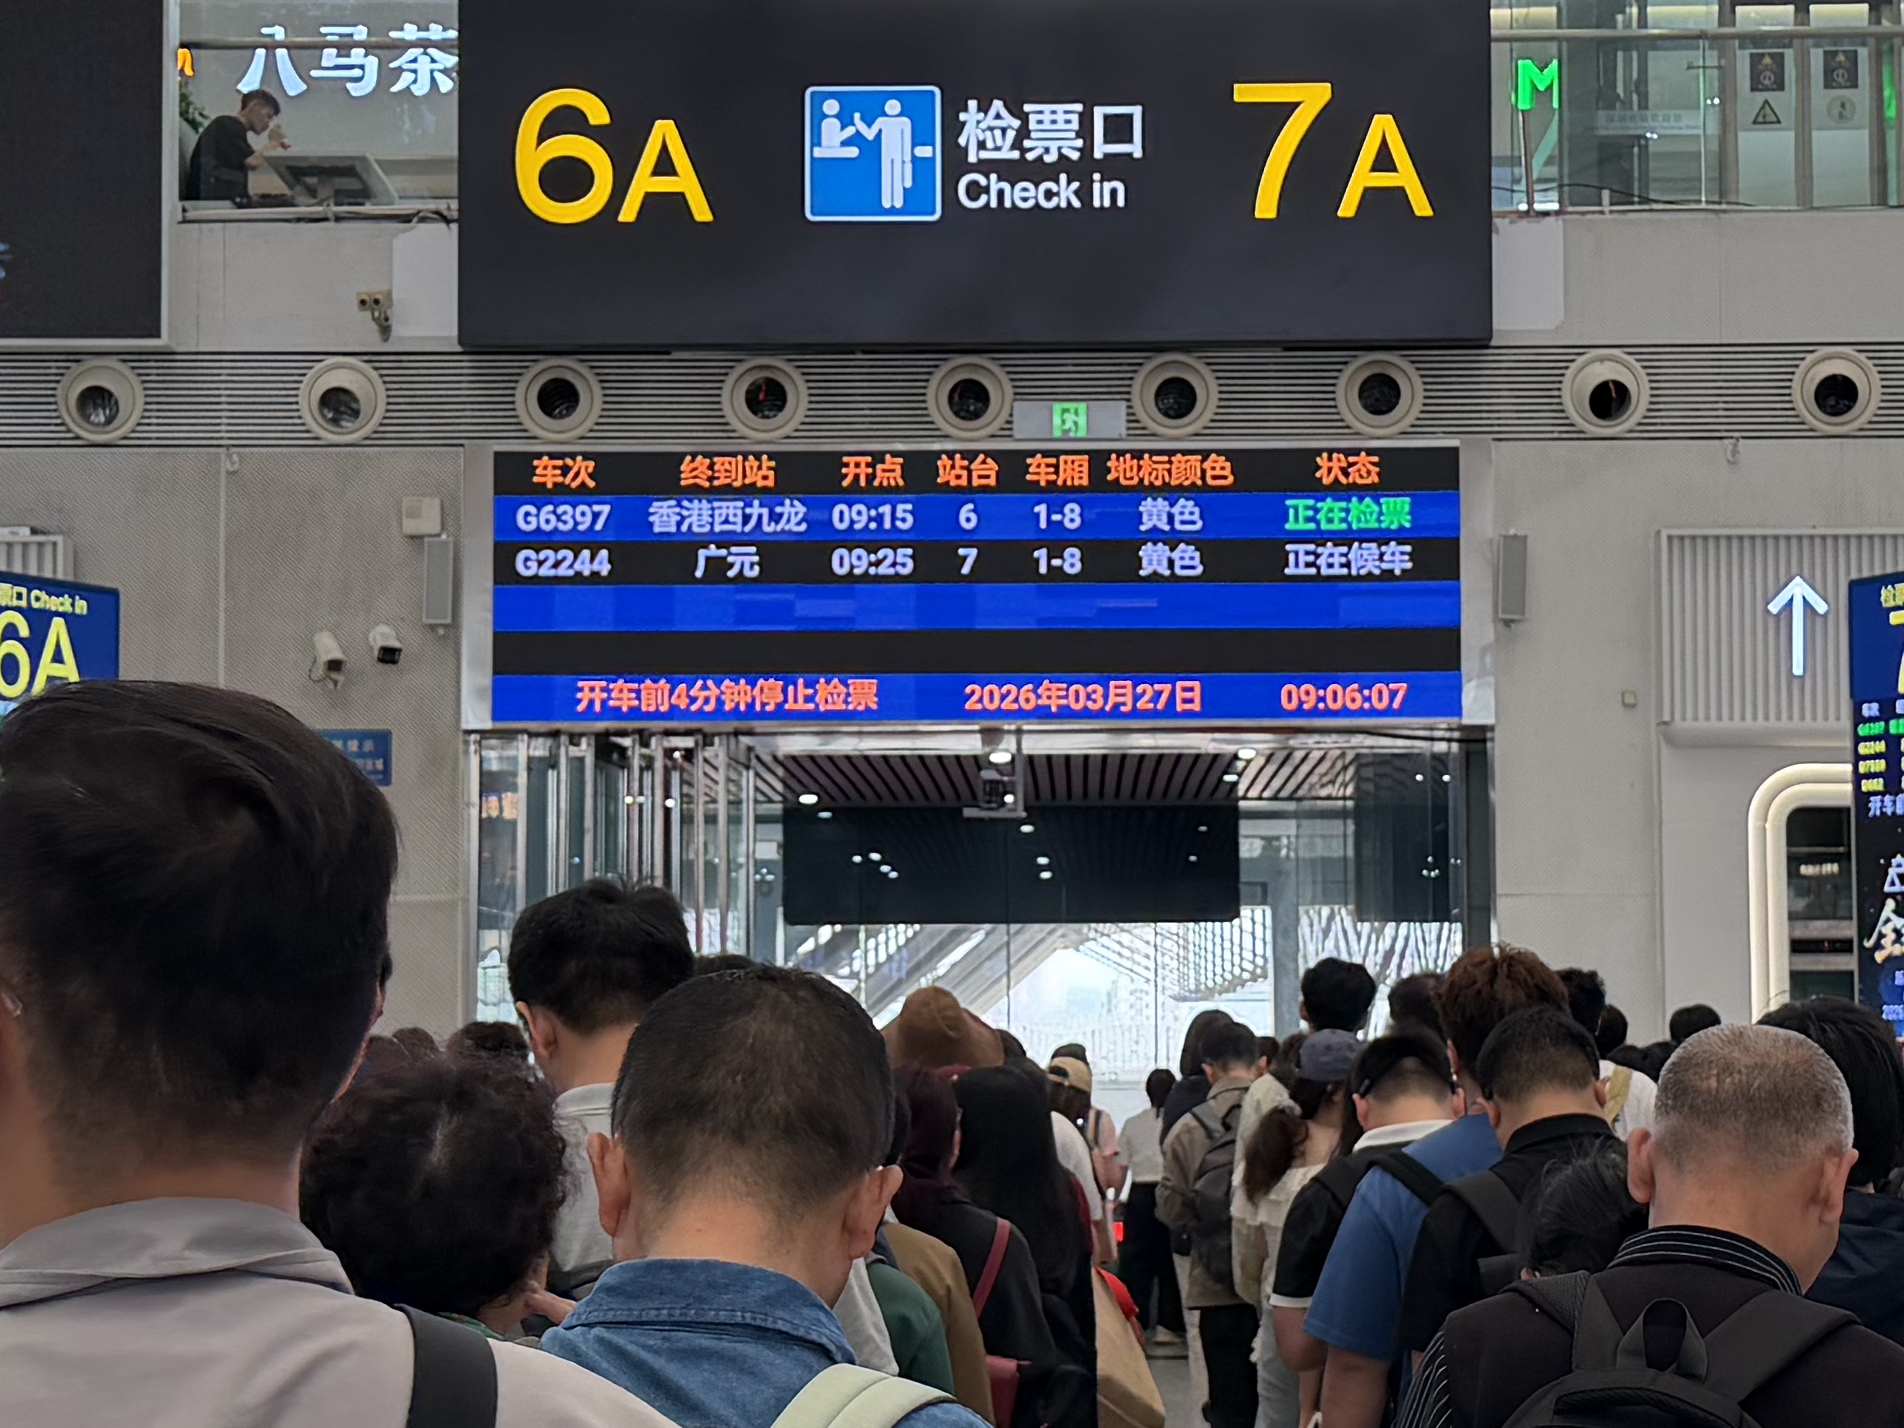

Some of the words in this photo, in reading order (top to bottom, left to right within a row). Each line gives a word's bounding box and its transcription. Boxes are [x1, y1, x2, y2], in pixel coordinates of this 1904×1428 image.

[957, 100, 1145, 165] 检票口
[1232, 82, 1435, 220] 7A
[513, 86, 715, 225] 6A
[956, 172, 1082, 211] Check
[1092, 172, 1126, 210] in
[532, 455, 596, 489] 车次
[679, 454, 776, 488] 终到站
[841, 453, 905, 488] 开点
[936, 453, 999, 487] 站台
[1025, 453, 1090, 487] 车厢
[1106, 452, 1235, 487] 地标颜色
[1315, 451, 1380, 486] 状态
[517, 504, 611, 531] G6397
[649, 498, 807, 533] 香港西九龙
[832, 503, 914, 530] 09:15
[959, 503, 977, 530] 6
[1033, 503, 1081, 530] 1-8
[1139, 497, 1203, 531] 黄色
[1284, 496, 1412, 531] 正在检票
[515, 548, 612, 577] G2244
[694, 543, 760, 578] 广元
[831, 547, 914, 575] 09:25
[957, 547, 978, 575] 7
[1033, 547, 1082, 574] 1-8
[1138, 541, 1204, 577] 黄色
[1284, 541, 1413, 576] 正在候车
[30, 589, 73, 614] Check
[75, 595, 88, 615] in
[576, 677, 879, 713] 开车前4分钟停止检票
[964, 679, 1202, 713] 2026年03月27日
[1280, 682, 1408, 711] 09:06:07
